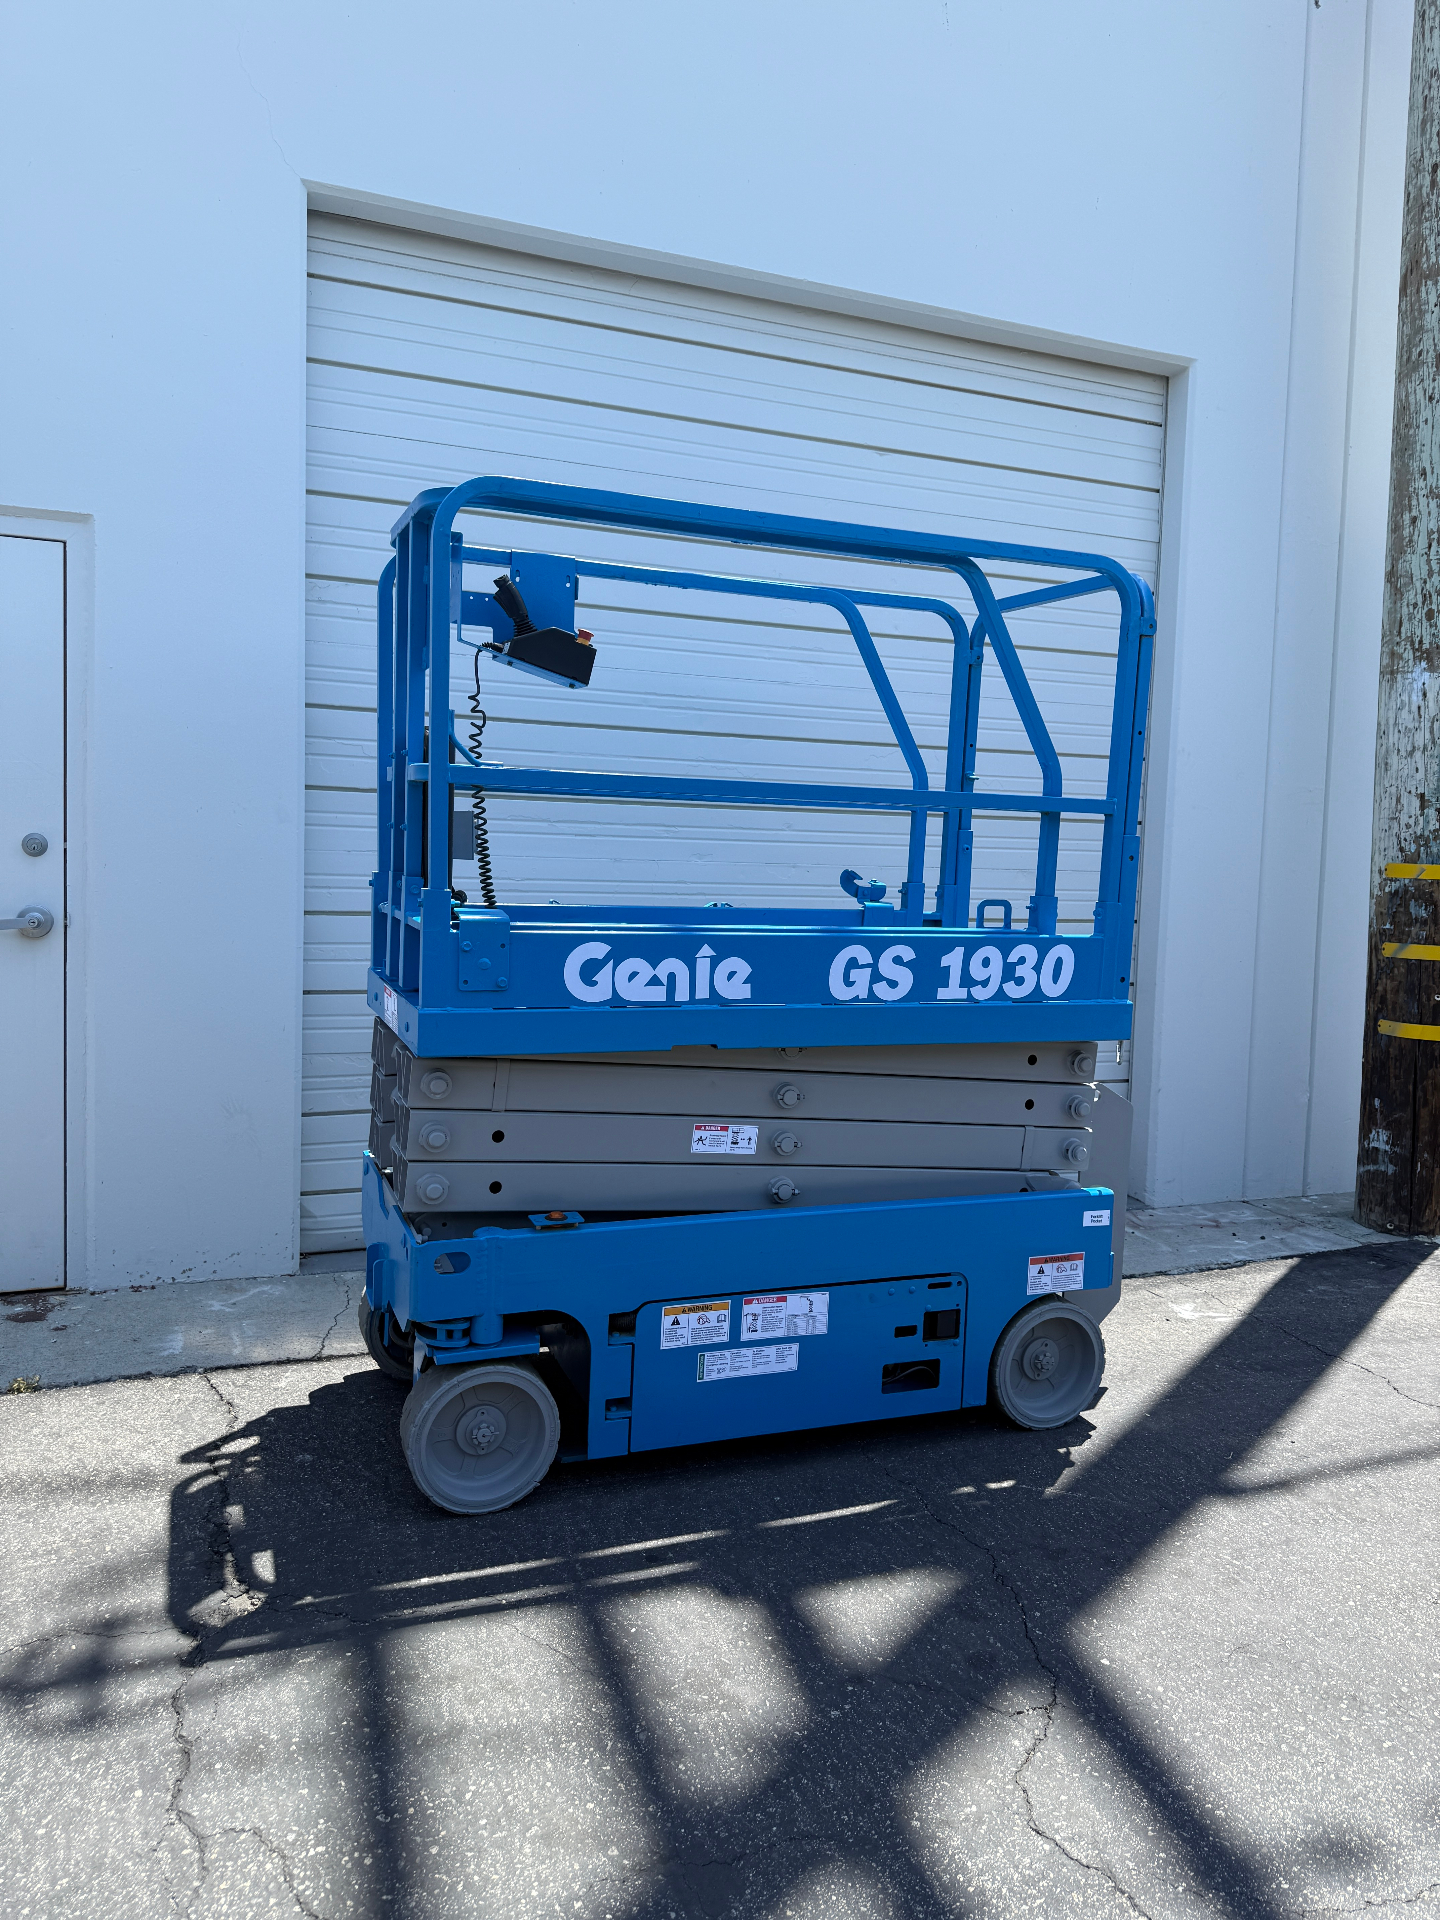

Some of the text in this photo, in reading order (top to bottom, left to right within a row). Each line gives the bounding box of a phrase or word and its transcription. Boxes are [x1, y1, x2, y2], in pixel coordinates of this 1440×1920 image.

[563, 941, 752, 1002] Genie
[828, 943, 1075, 1000] GS 1930
[687, 1304, 713, 1313] WARNING
